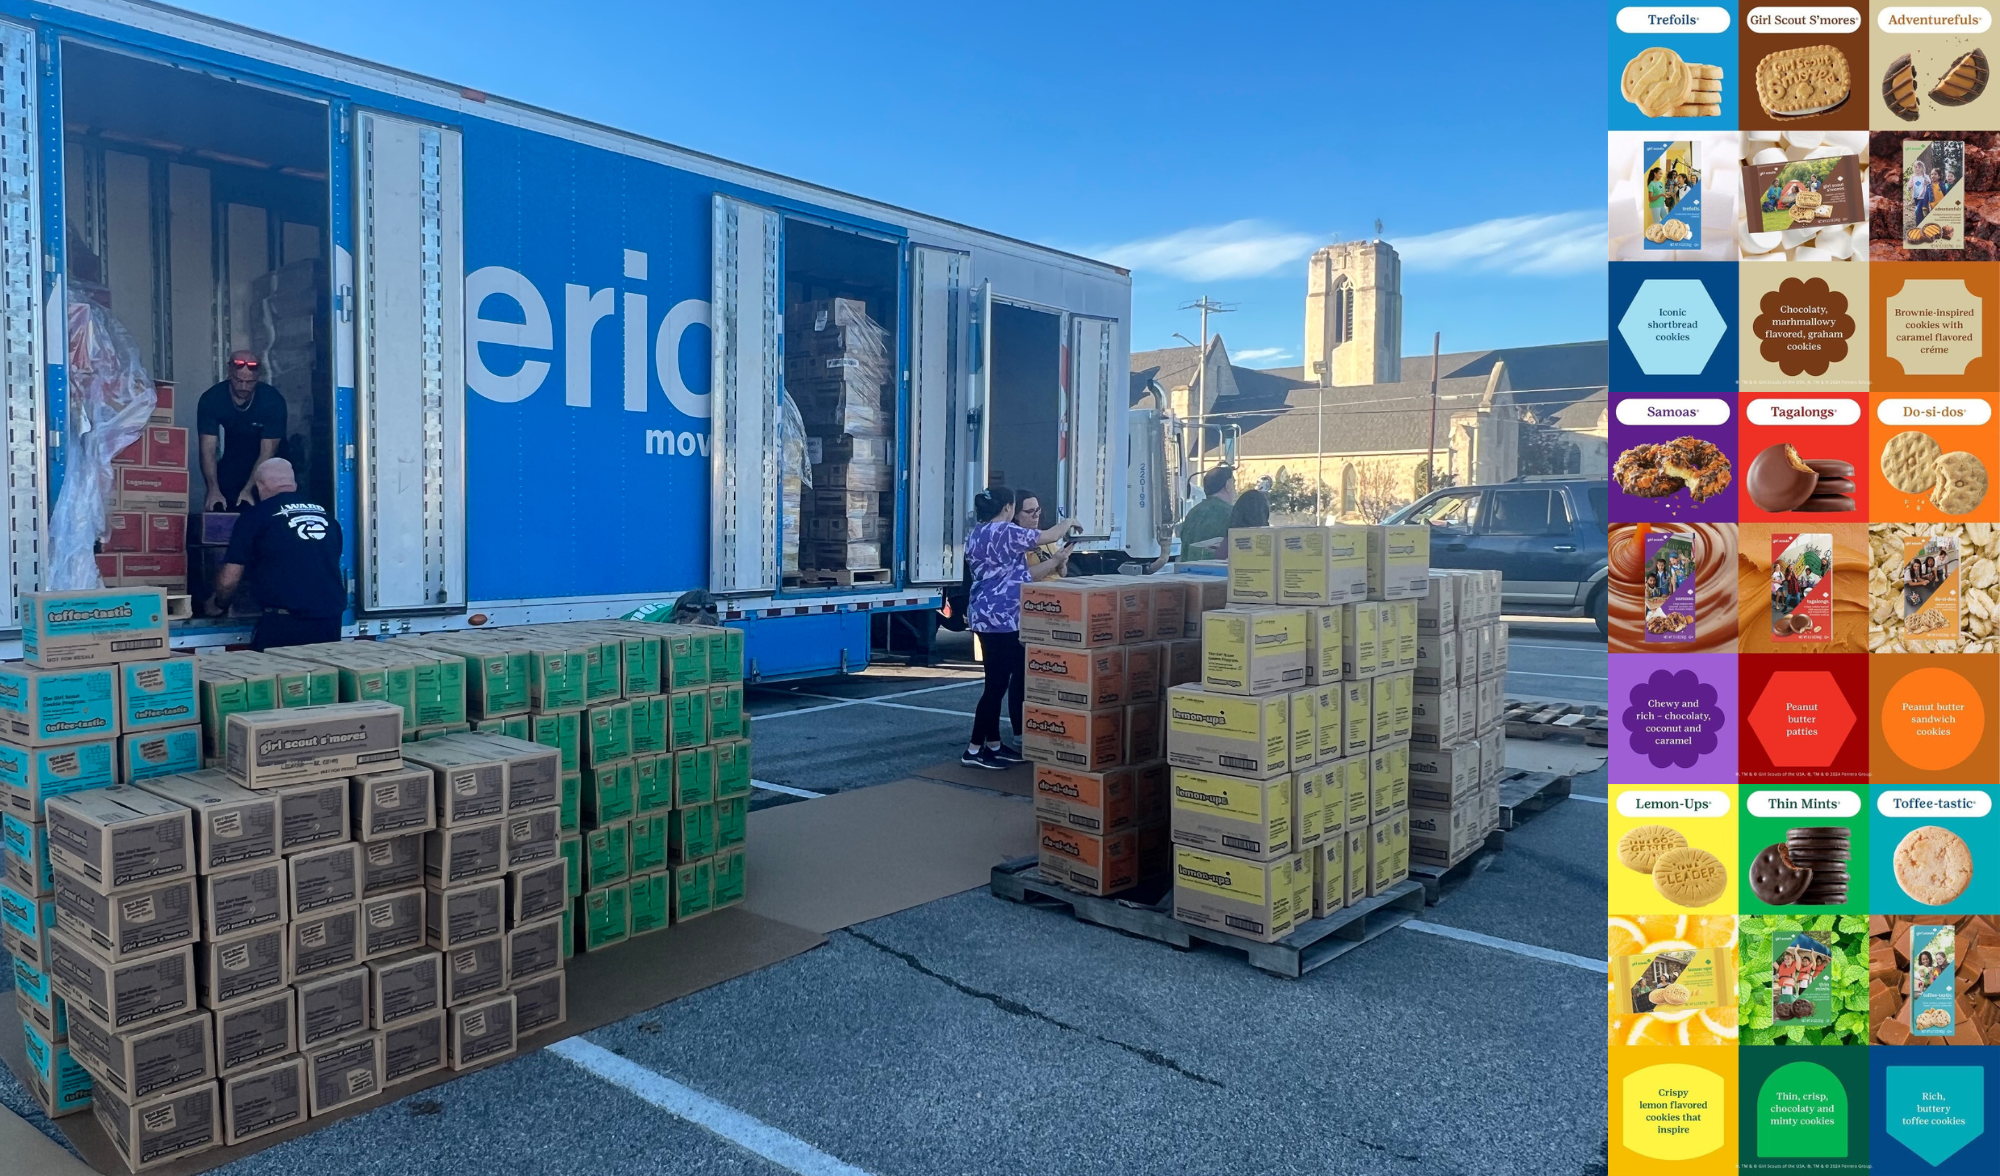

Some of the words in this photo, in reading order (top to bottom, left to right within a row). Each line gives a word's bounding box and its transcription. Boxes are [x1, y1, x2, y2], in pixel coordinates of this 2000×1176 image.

[48, 606, 132, 622] toffee-tastic
[260, 740, 282, 755] girl
[284, 737, 318, 749] scout
